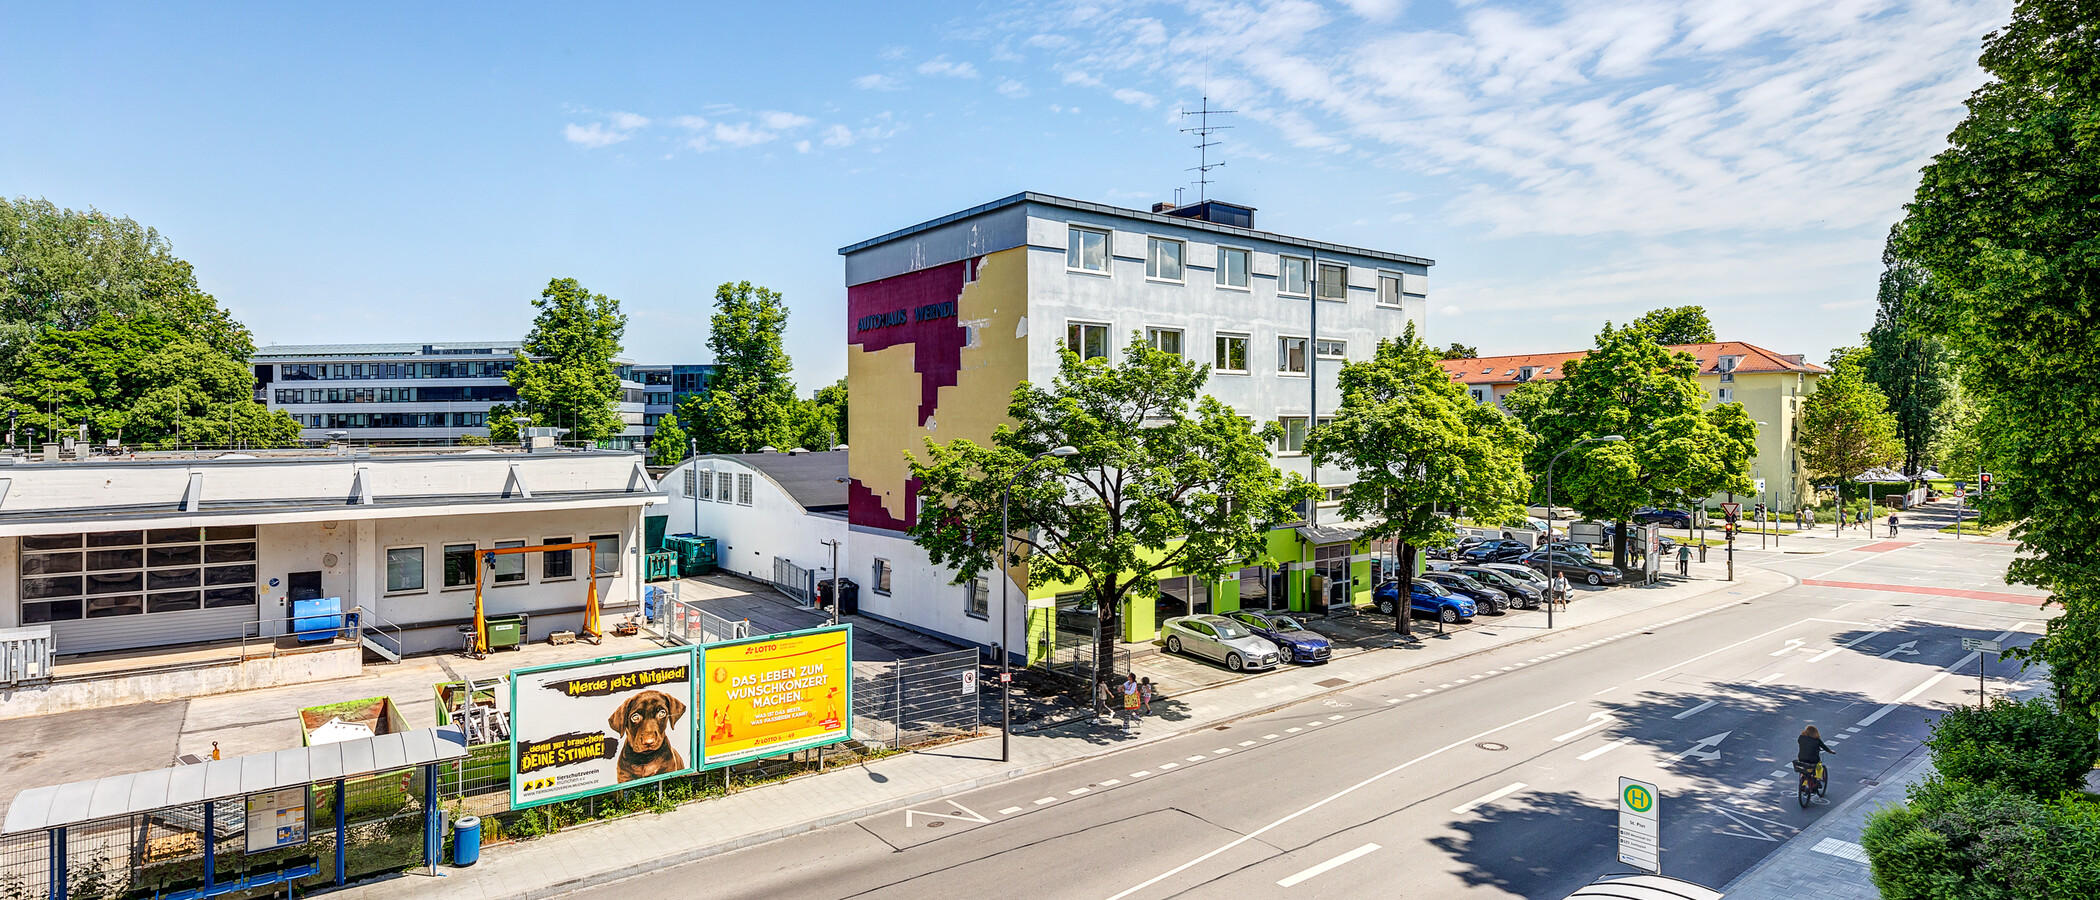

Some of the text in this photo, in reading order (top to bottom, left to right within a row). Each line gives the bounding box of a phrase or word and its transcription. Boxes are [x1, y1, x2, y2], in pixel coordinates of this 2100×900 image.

[857, 300, 956, 332] AUTOHAUS WERNDL
[755, 644, 776, 654] LOTTO
[568, 666, 685, 696] Werde jetzt Mitglied!
[732, 664, 824, 688] DAS LEBEN ZUM
[726, 675, 828, 700] WUNSCHKONZERT
[753, 692, 804, 708] MACHEN.
[552, 740, 564, 750] wir
[567, 733, 604, 747] brauchen
[761, 736, 777, 745] LOTTO
[521, 751, 555, 772] DEINE
[558, 742, 605, 763] STIMME!
[556, 768, 600, 780] tierschutzverein
[1632, 790, 1644, 807] H
